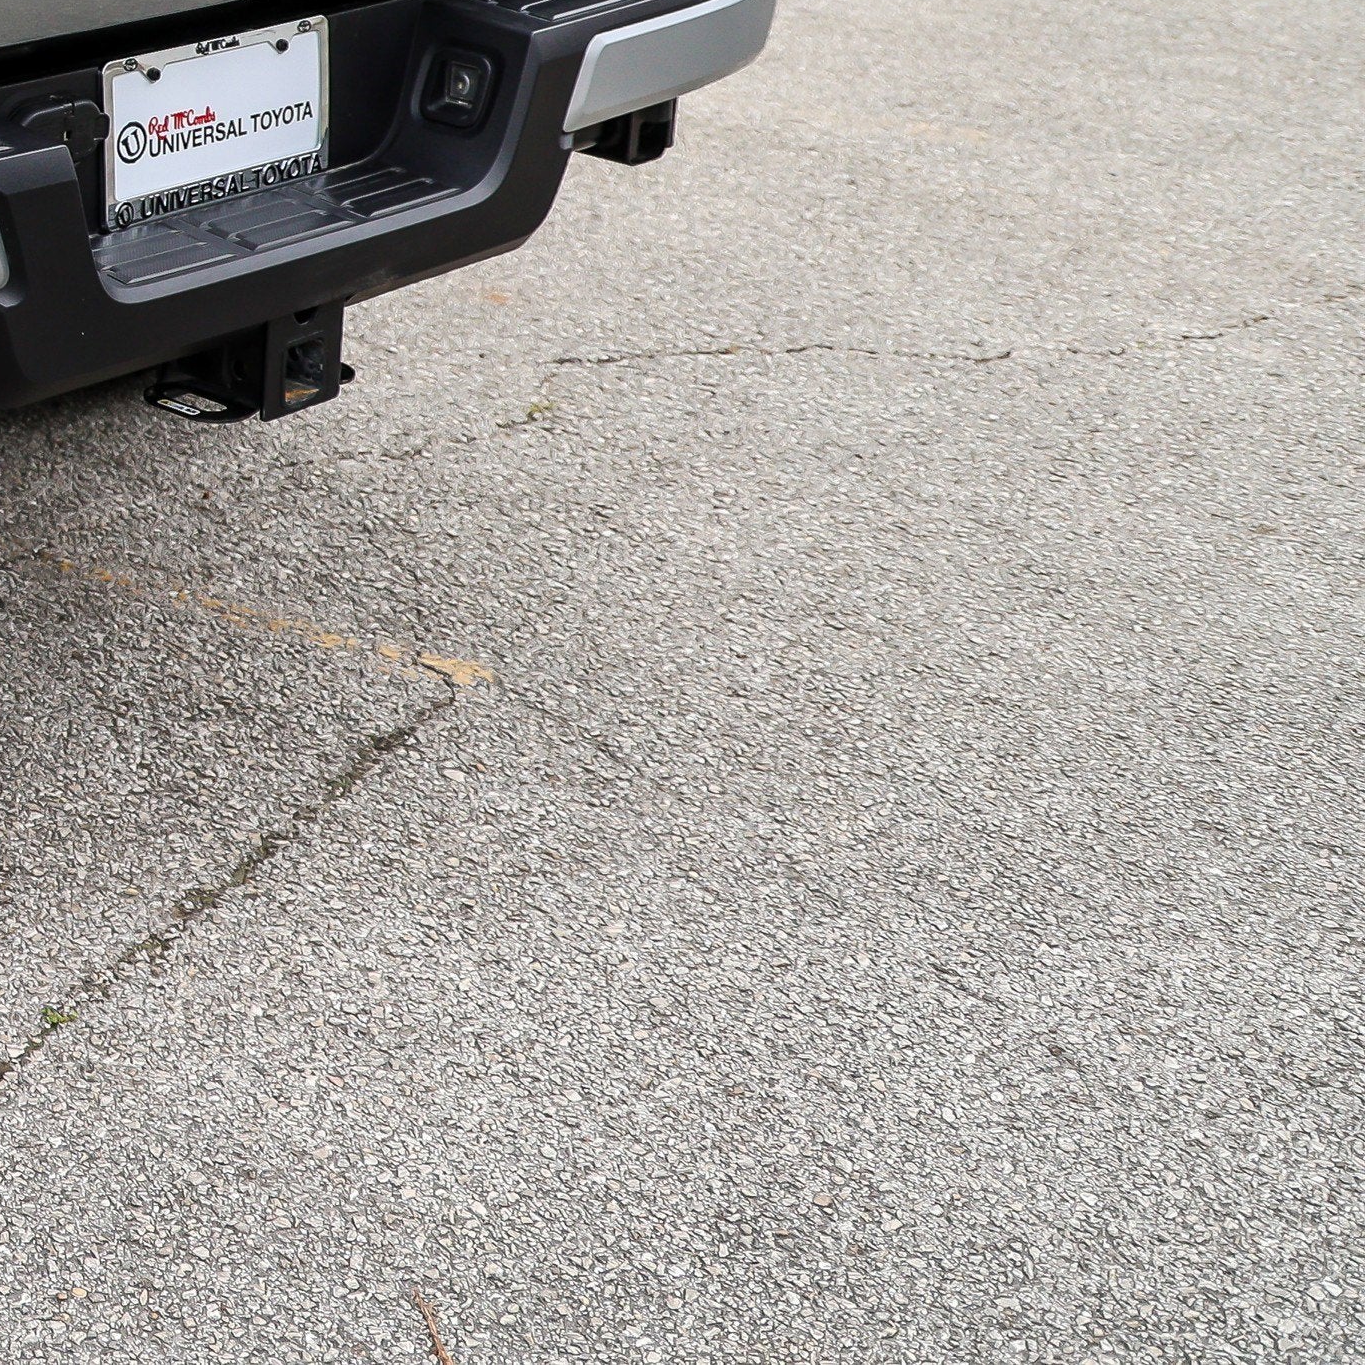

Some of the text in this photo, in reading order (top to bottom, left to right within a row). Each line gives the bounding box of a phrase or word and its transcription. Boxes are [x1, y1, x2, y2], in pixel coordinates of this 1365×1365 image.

[147, 100, 314, 158] UNIVERSAL TOYOTA
[148, 115, 170, 141] Red
[139, 171, 251, 220] UNIVERSAL
[252, 152, 324, 186] TOYOTA
